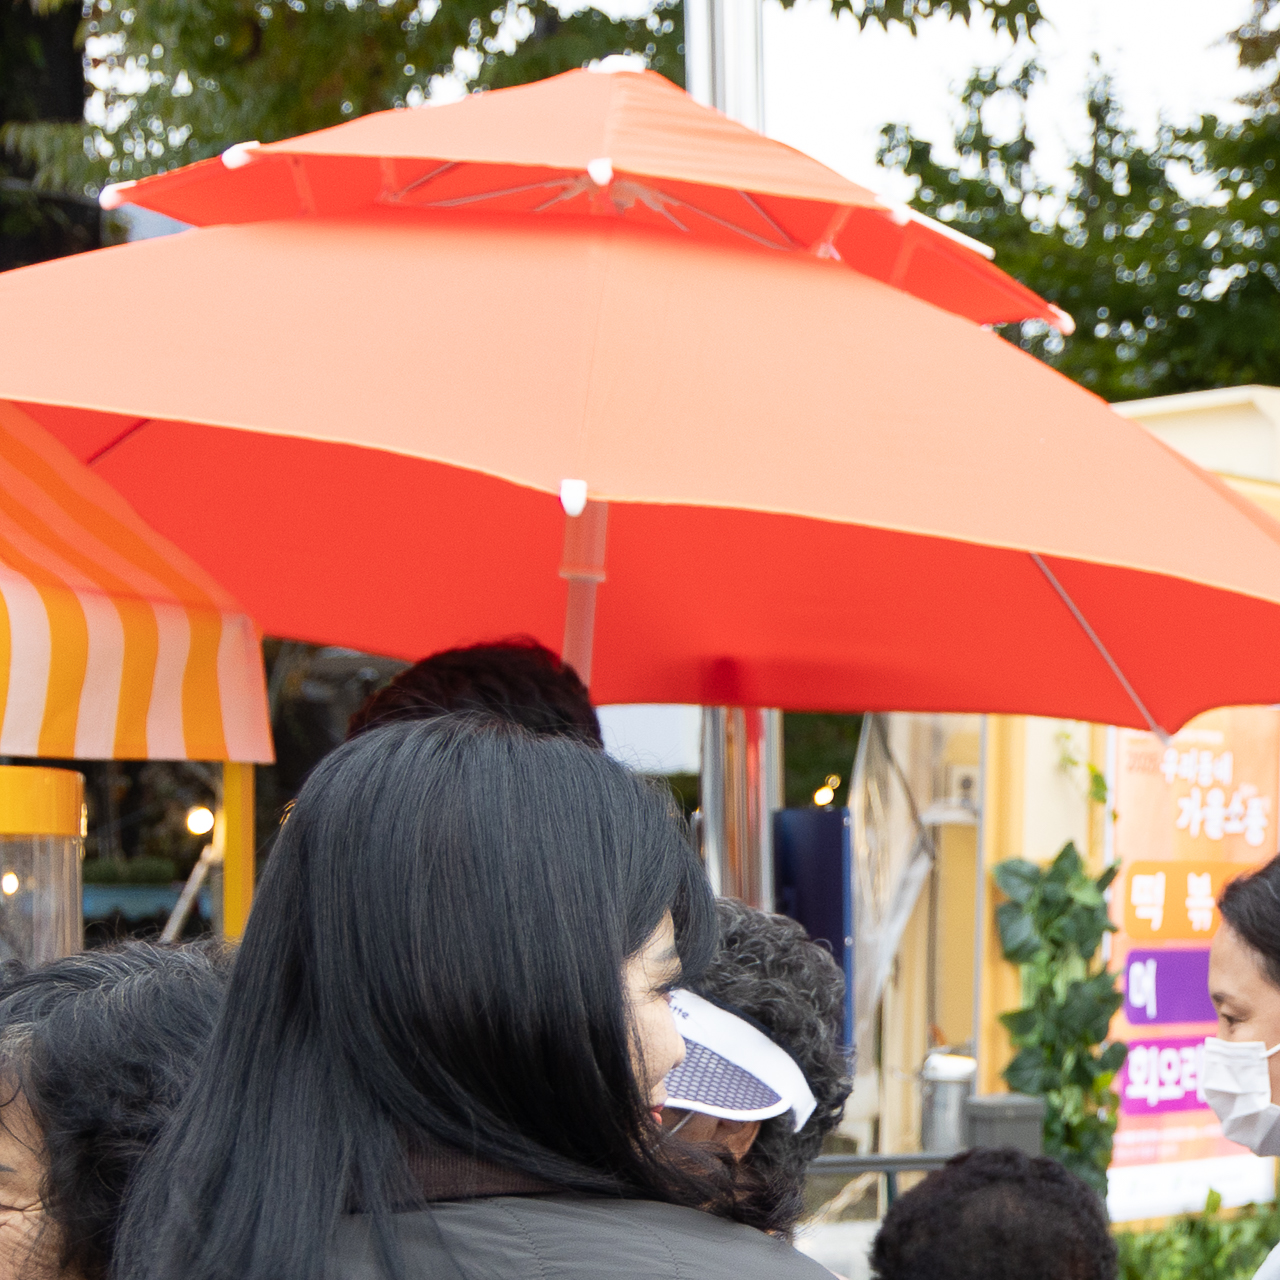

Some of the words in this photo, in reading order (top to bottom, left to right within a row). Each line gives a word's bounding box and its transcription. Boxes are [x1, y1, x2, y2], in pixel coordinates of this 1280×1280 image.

[1158, 747, 1234, 787] 우리동네
[1176, 787, 1268, 846] 가을소풍
[1131, 871, 1216, 932] 떡볶
[1128, 957, 1157, 1020] 어
